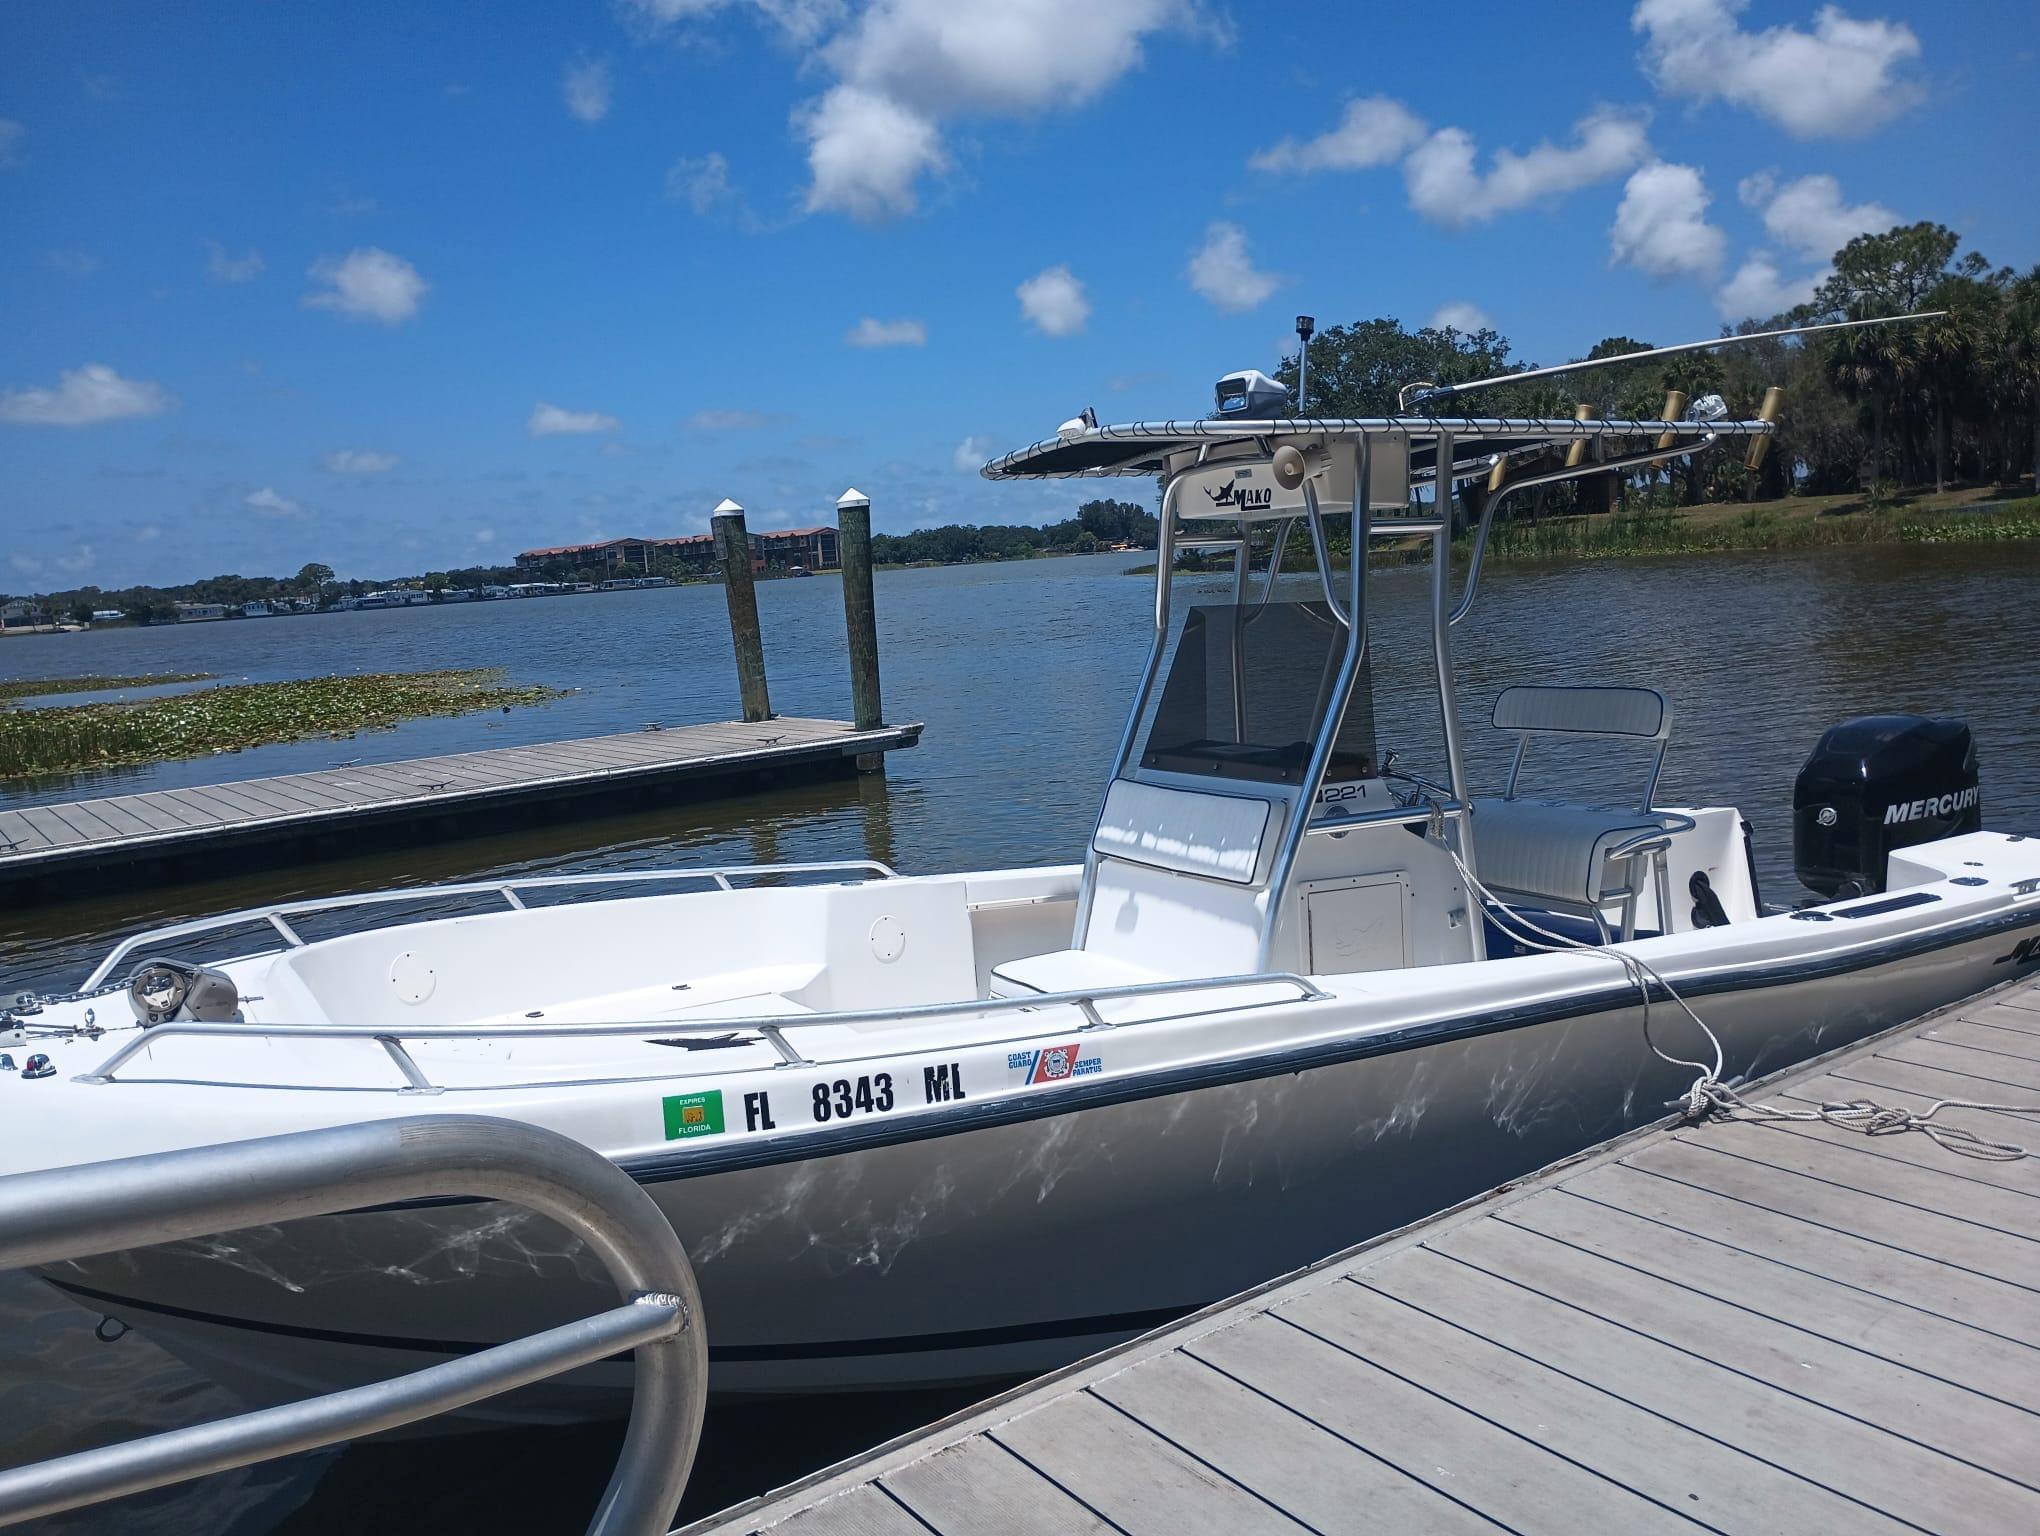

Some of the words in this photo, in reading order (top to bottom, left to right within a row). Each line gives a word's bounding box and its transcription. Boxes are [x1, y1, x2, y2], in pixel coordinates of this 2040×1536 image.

[1233, 487, 1272, 511] MAKO
[1883, 786, 1979, 825] MERCURY
[1007, 1051, 1031, 1063] COAST
[1075, 1057, 1102, 1069] SEMPER
[1008, 1059, 1032, 1069] GUARD
[1072, 1065, 1103, 1077] PARATUS
[679, 1096, 706, 1106] EXPIRES
[743, 1091, 776, 1132] FL
[812, 1072, 894, 1122] 8343
[923, 1063, 966, 1104] ML
[678, 1123, 711, 1135] FLORIDA
